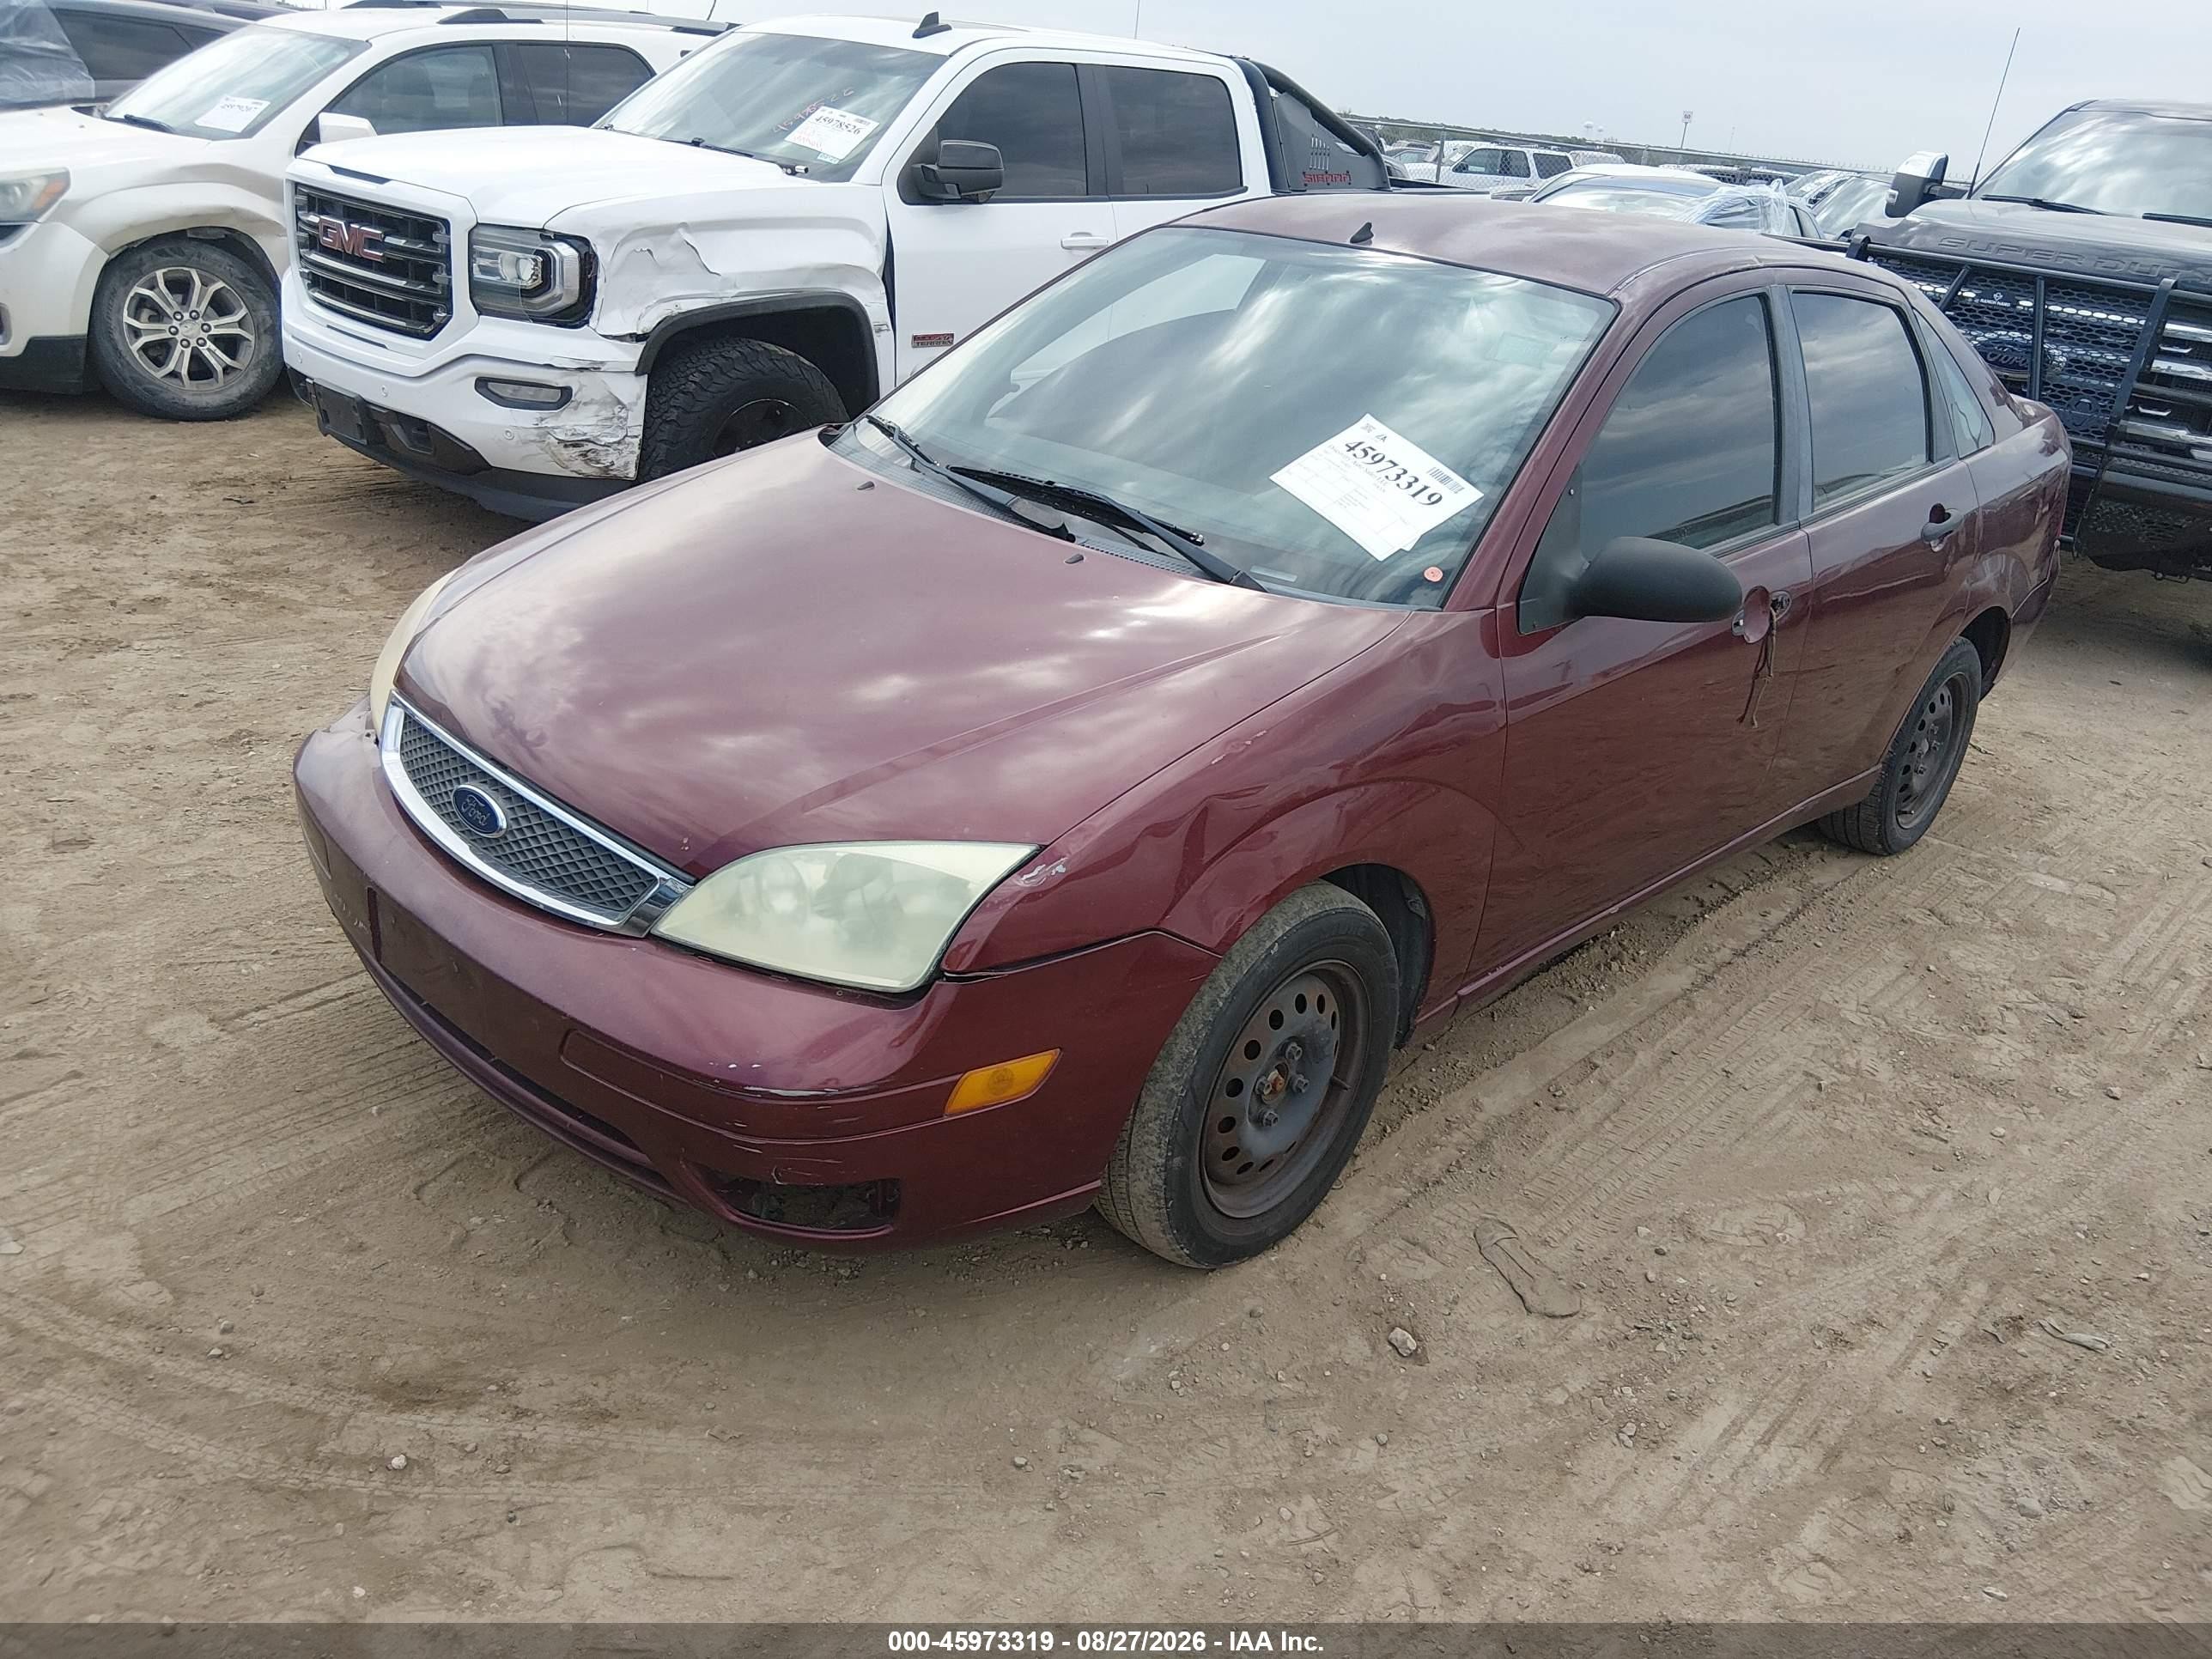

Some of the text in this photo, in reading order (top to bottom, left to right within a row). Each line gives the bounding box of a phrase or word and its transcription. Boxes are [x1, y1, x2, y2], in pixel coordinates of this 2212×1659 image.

[319, 216, 385, 264] GMC
[1938, 237, 2086, 265] SUPER
[1345, 441, 1443, 507] 45973319
[461, 794, 491, 826] Ford
